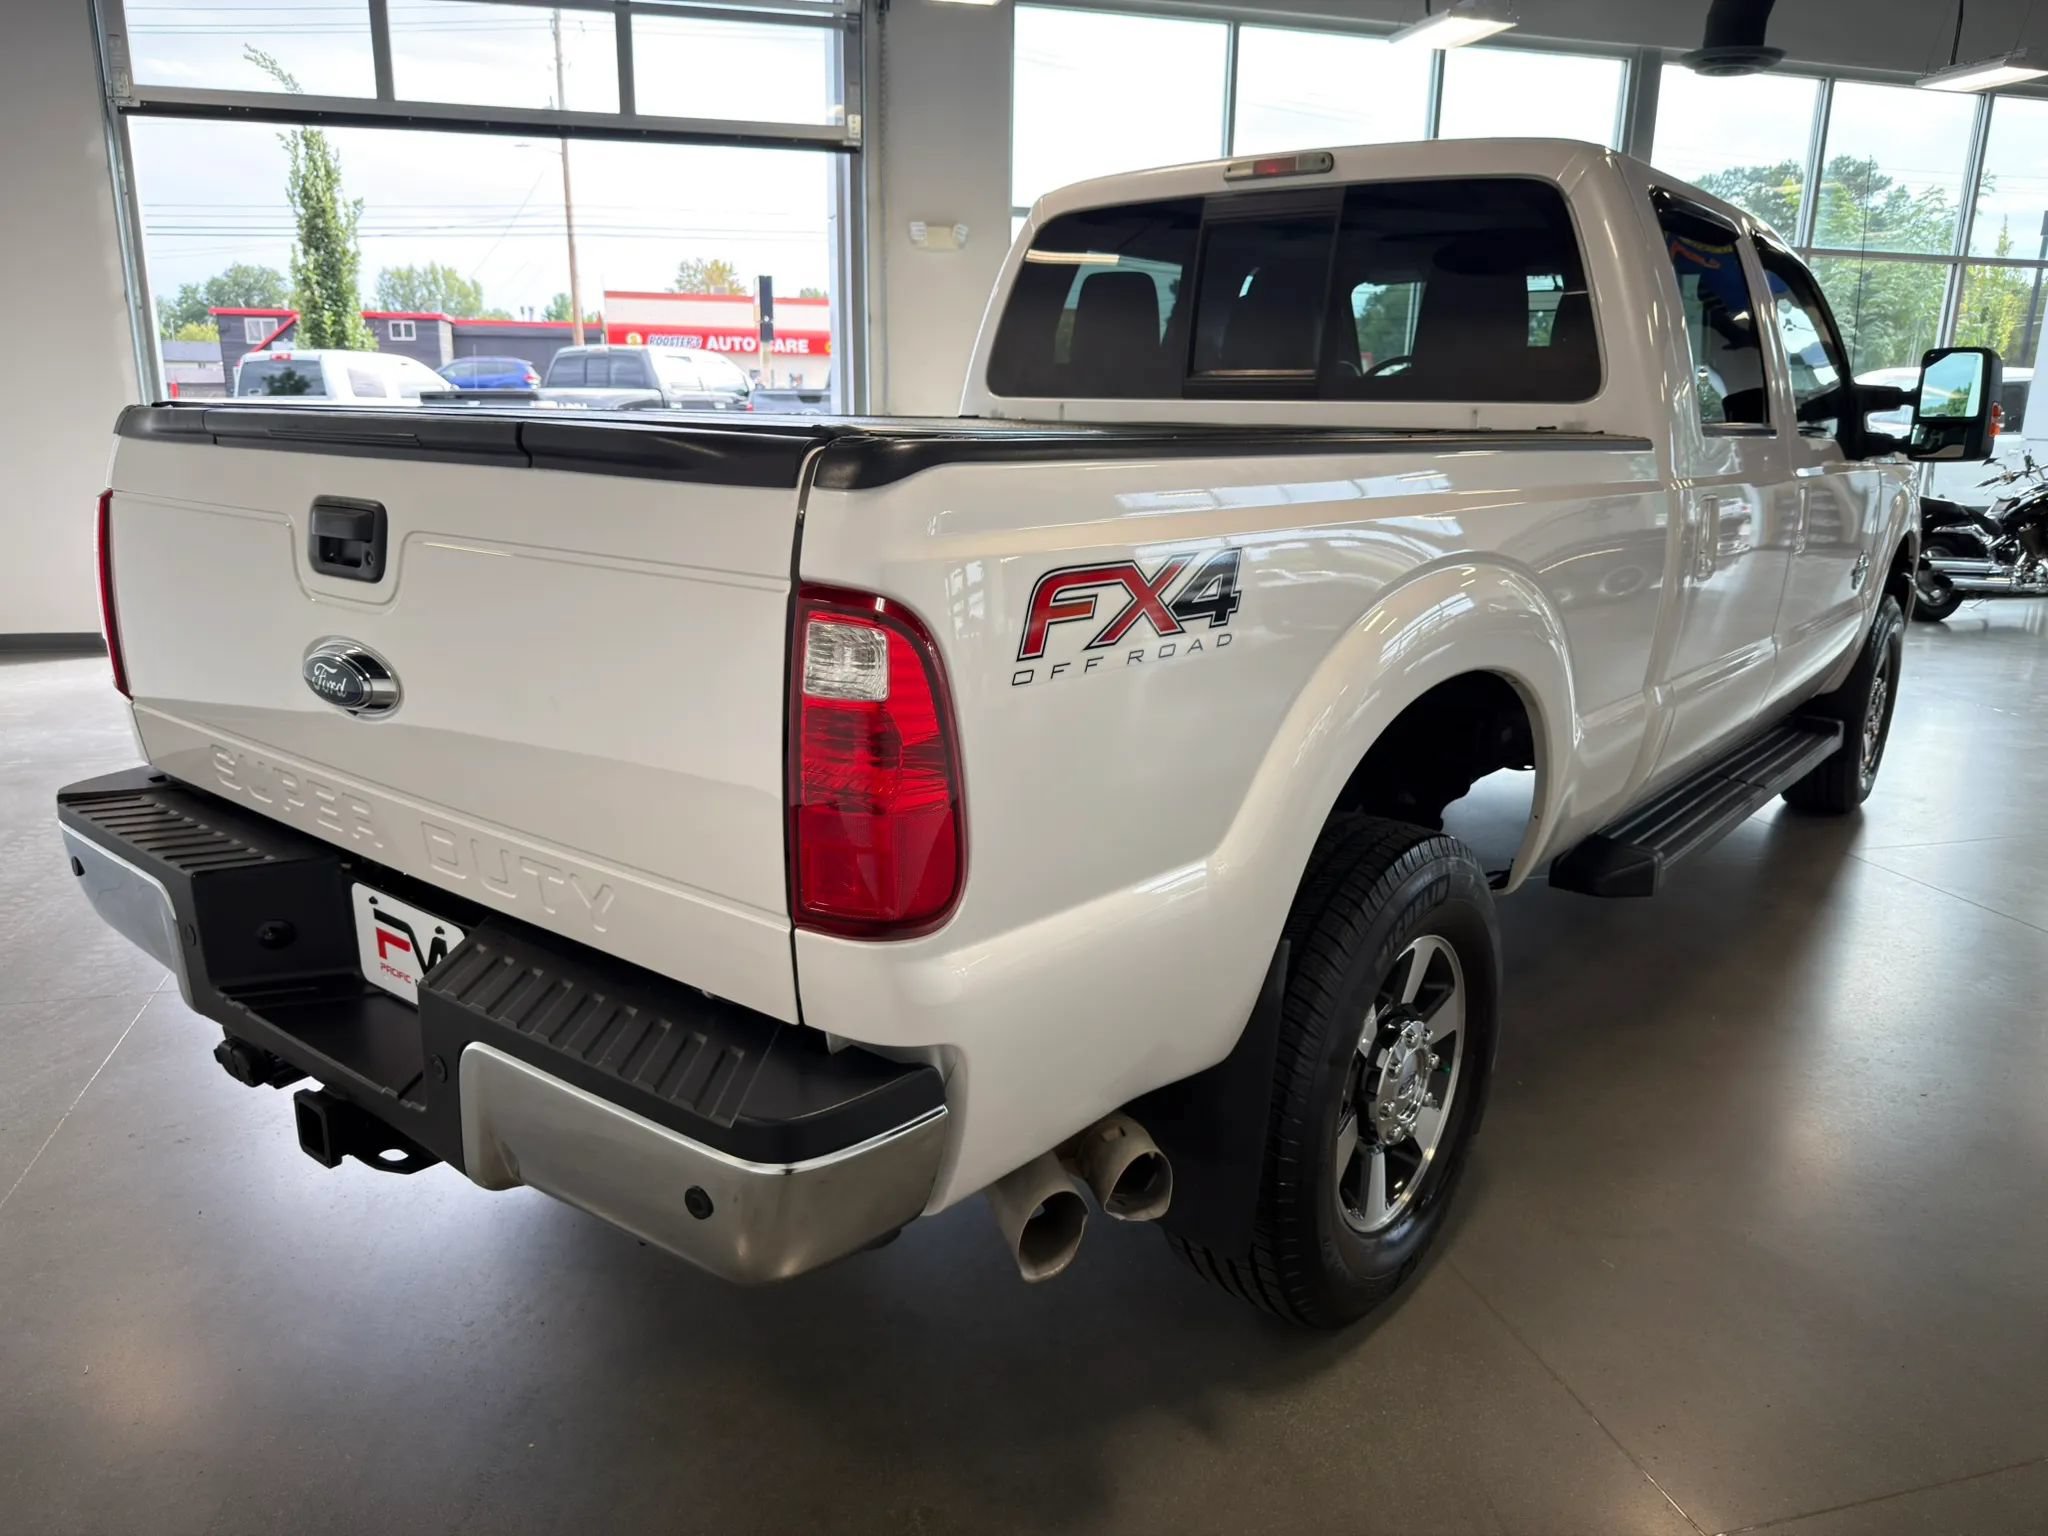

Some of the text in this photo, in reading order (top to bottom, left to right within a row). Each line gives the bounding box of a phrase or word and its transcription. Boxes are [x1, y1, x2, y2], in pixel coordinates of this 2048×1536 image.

[707, 336, 757, 352] AUTO
[1016, 547, 1242, 662] FX4
[312, 662, 347, 698] Ford
[1012, 633, 1233, 686] OFF ROAD
[210, 743, 616, 933] SUPER DUTY
